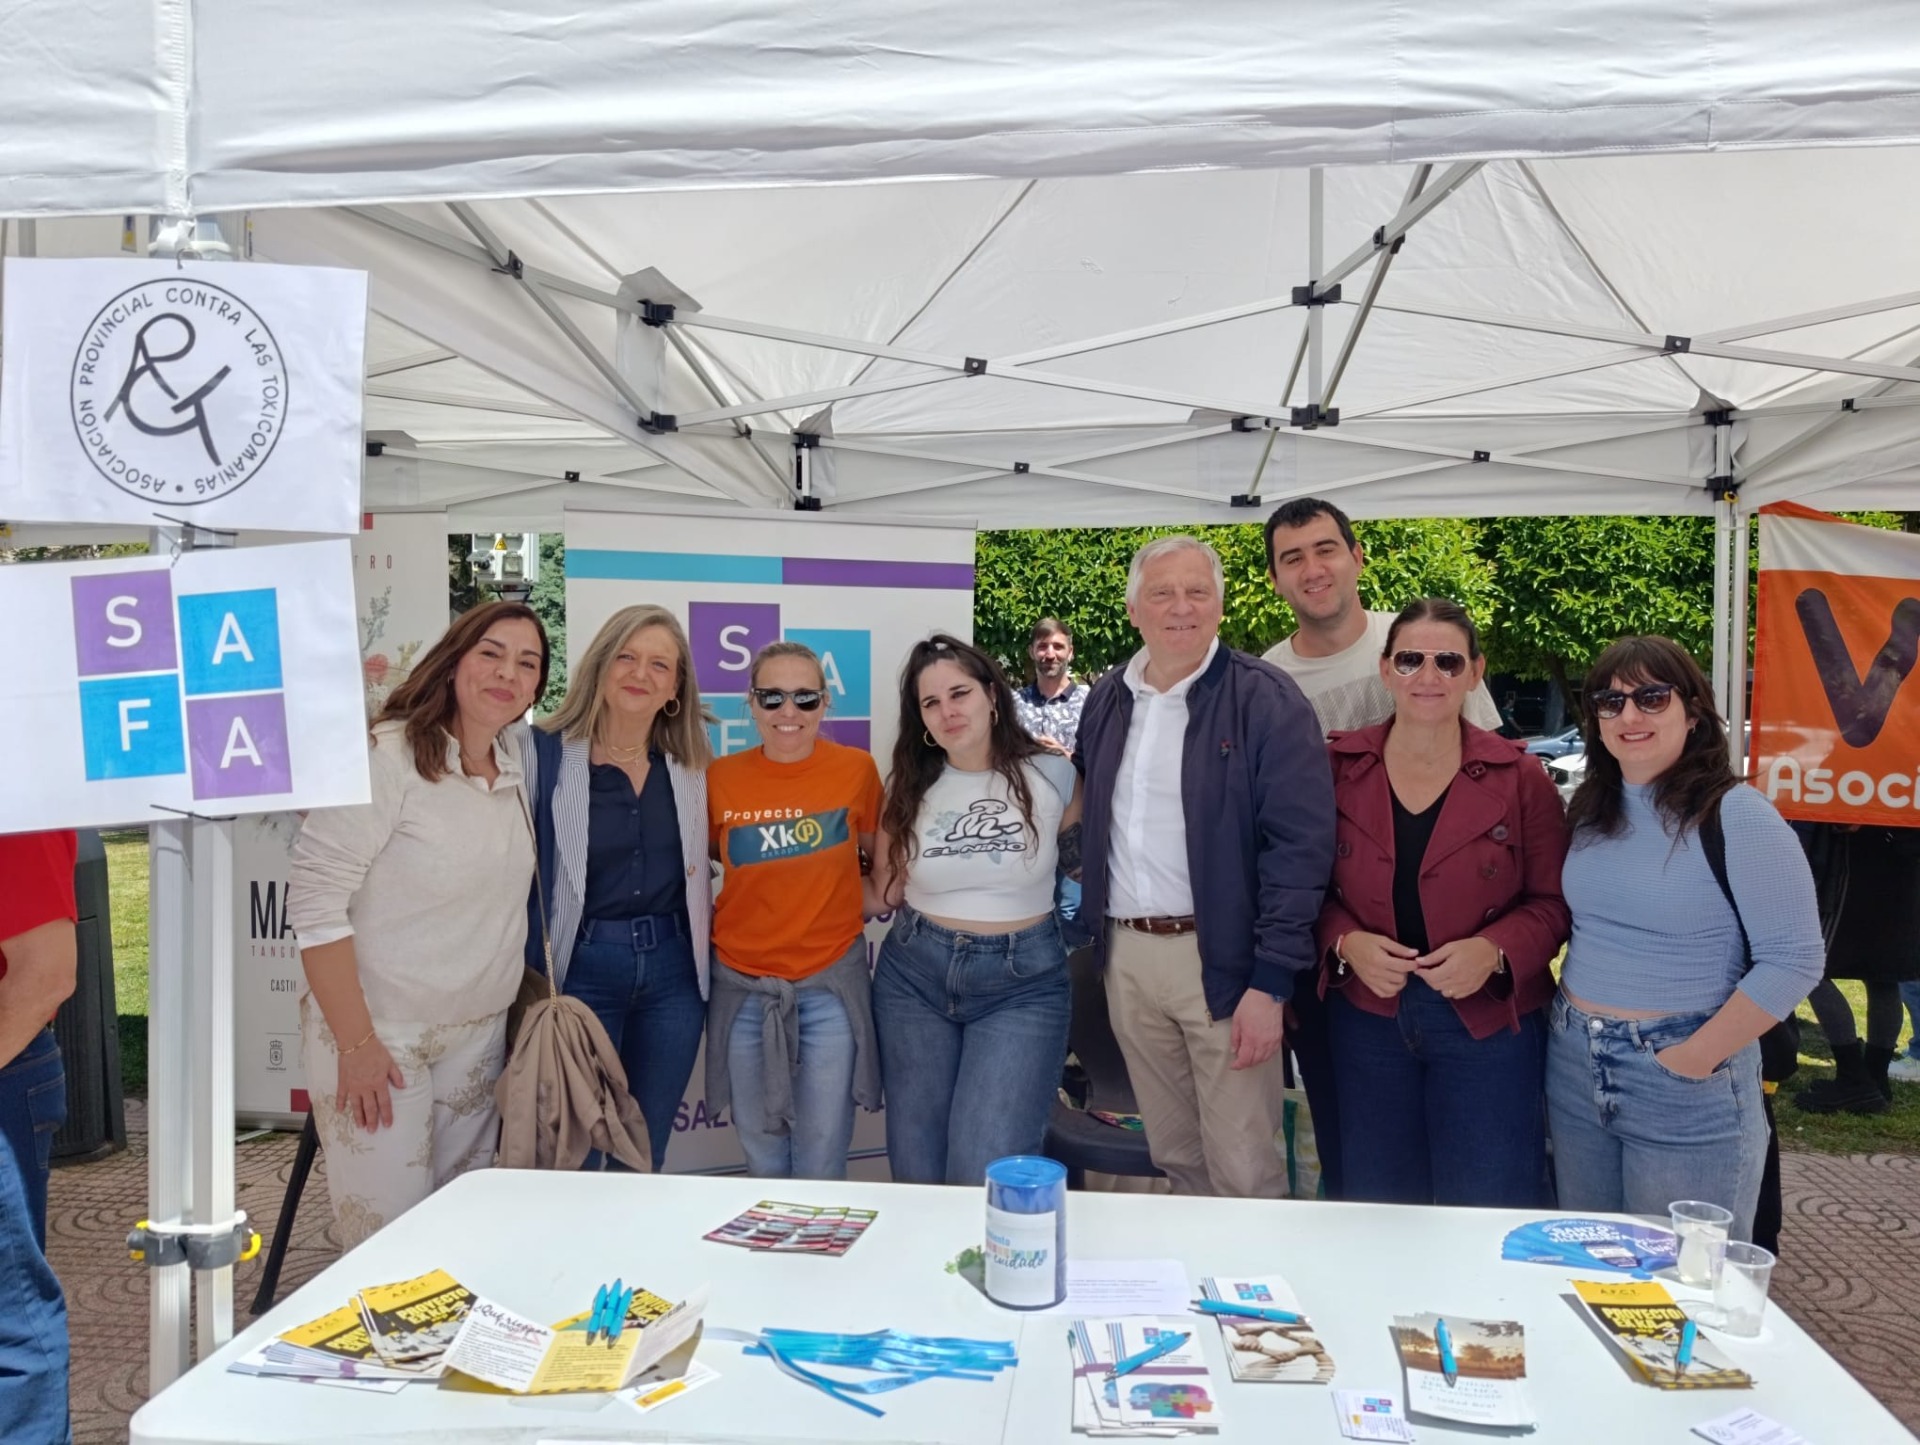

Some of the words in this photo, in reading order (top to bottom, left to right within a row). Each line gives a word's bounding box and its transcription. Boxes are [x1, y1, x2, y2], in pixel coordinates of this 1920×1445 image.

[165, 287, 243, 327] CONTRA
[79, 292, 154, 386] PROVINCIAL
[244, 328, 274, 367] LAS
[79, 399, 166, 494] ASOCIACIÓN
[194, 374, 280, 495] TOXICOMANIAS
[724, 807, 804, 823] Proyecto
[395, 1287, 471, 1321] PROYECTO
